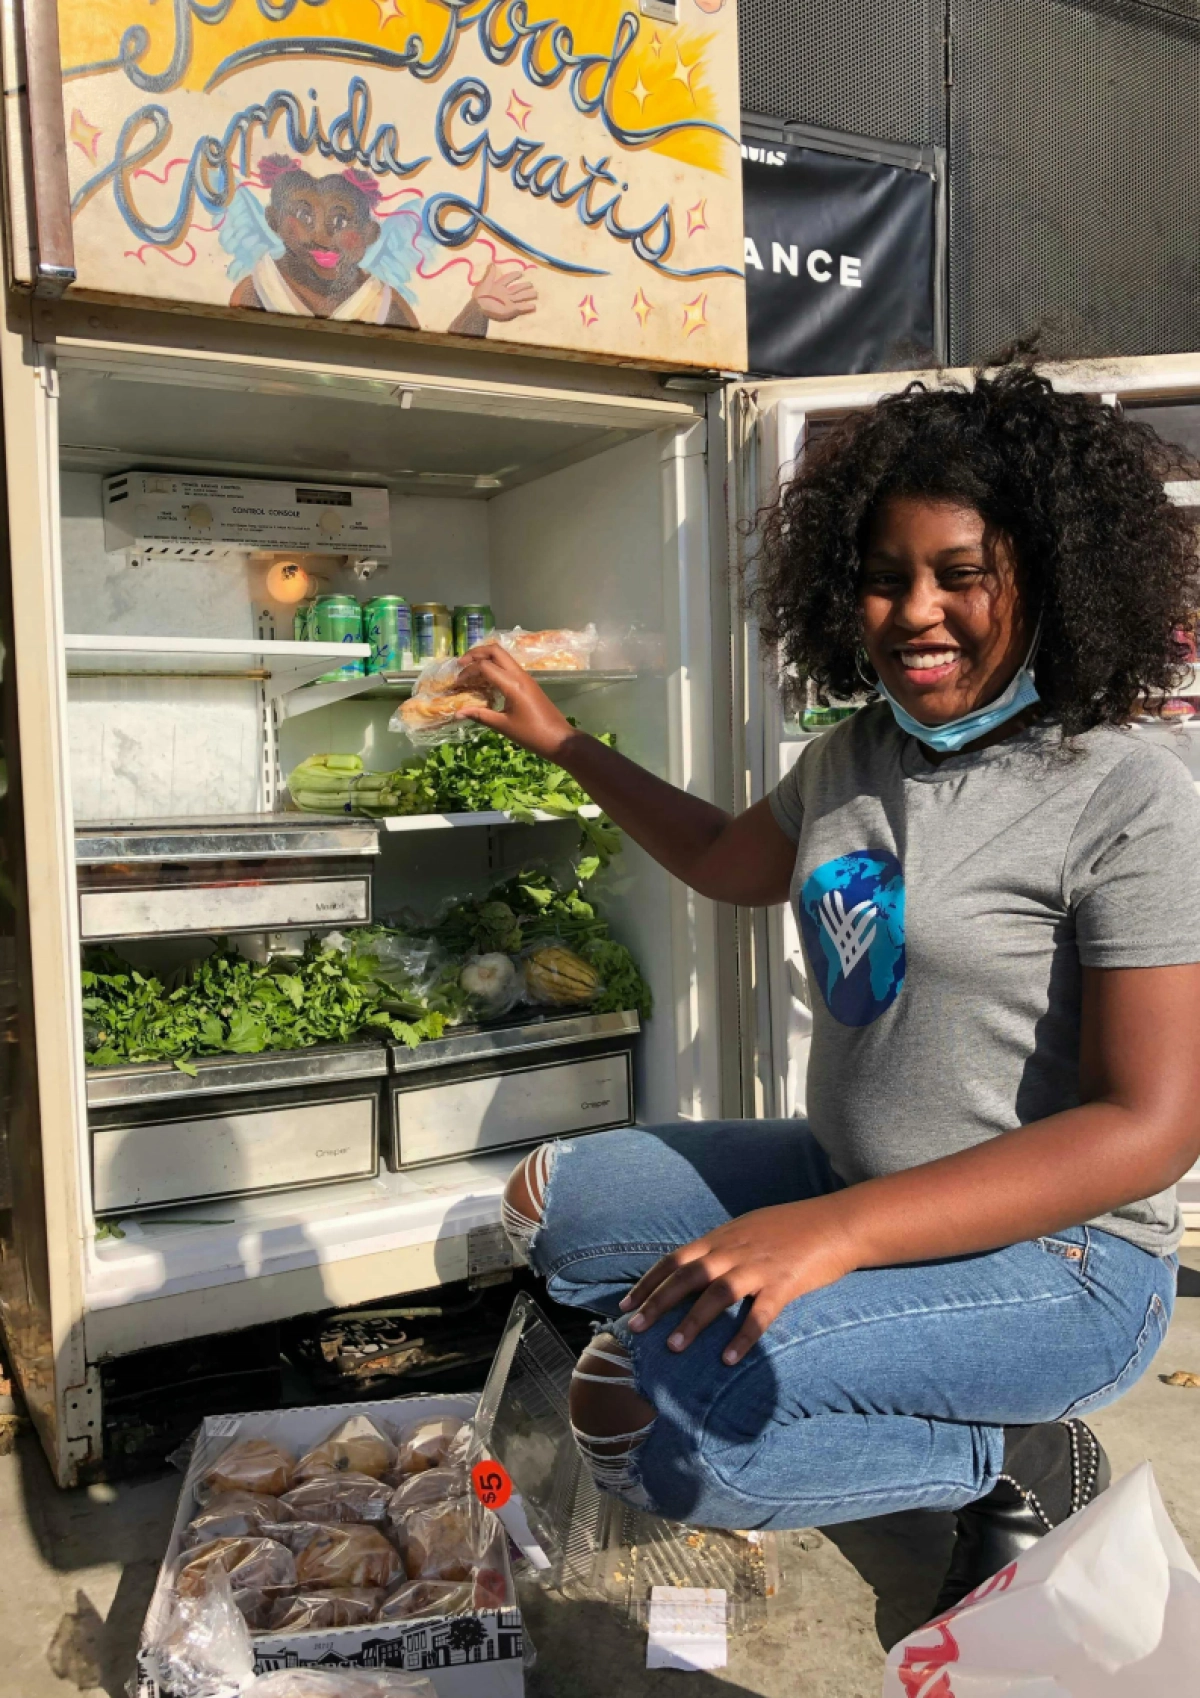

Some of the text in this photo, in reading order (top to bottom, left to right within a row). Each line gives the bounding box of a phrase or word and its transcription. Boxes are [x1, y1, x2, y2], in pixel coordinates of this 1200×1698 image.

[72, 75, 745, 280] Comida Gratis
[231, 506, 301, 518] CONTROL CONSOLE
[480, 1473, 502, 1504] $5
